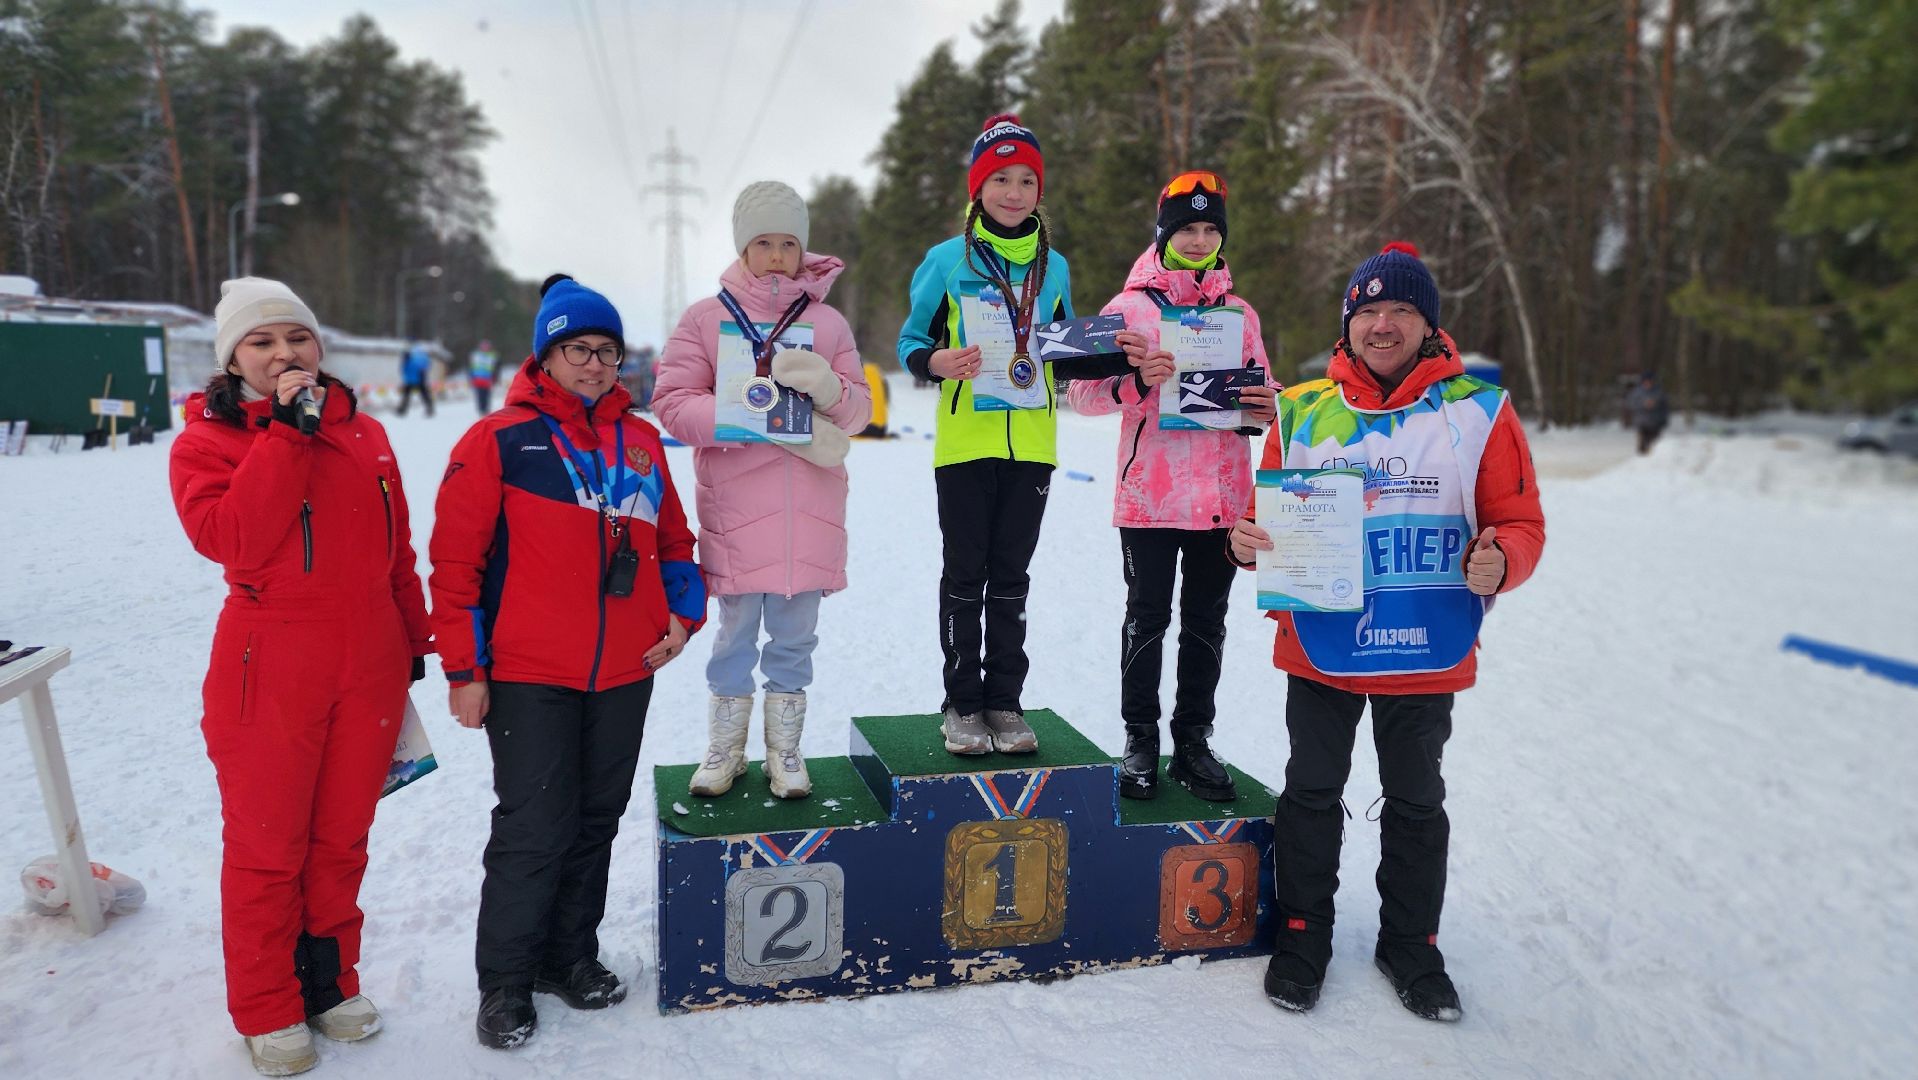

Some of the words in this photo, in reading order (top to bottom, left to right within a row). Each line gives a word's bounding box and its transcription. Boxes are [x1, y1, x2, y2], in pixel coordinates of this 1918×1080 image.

[983, 126, 1025, 143] LUKOIL
[982, 312, 1010, 321] ГРАМО
[1180, 336, 1223, 345] ГРАМОТА
[1281, 503, 1337, 513] ГРАМОТА
[1364, 527, 1461, 577] ЕНЕР
[983, 843, 1025, 926] 1
[1184, 859, 1233, 931] 3
[758, 885, 811, 964] 2
